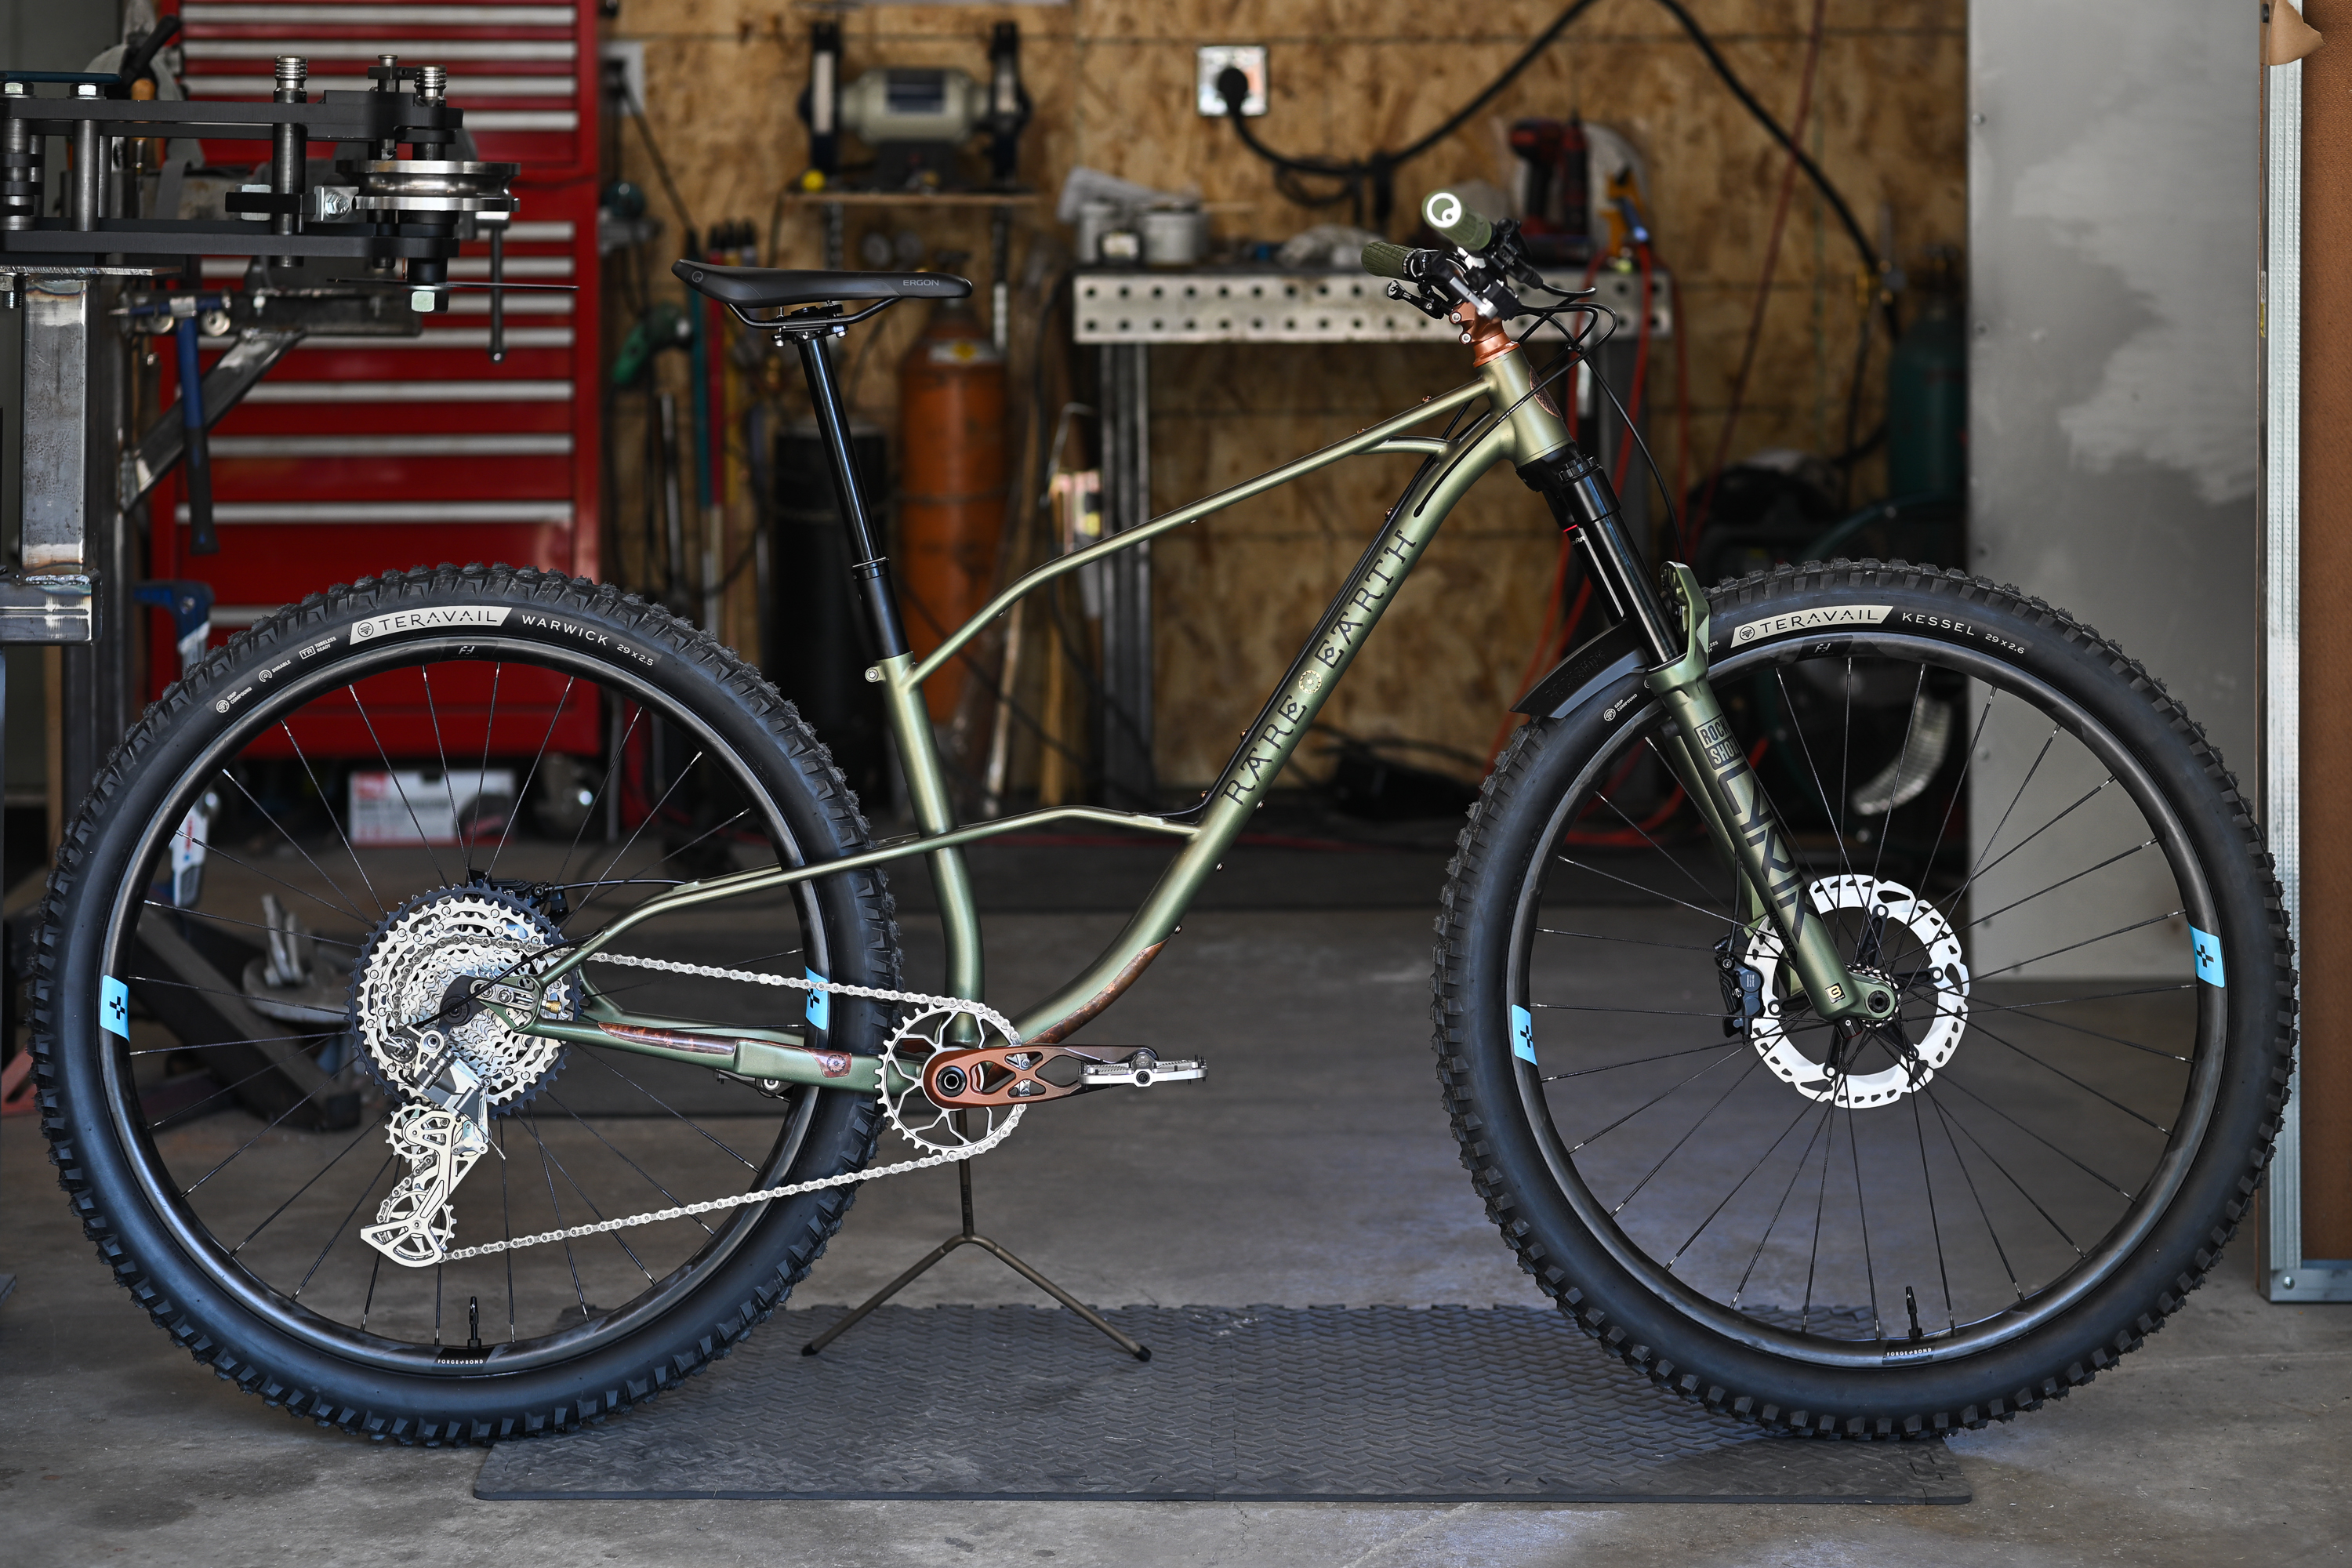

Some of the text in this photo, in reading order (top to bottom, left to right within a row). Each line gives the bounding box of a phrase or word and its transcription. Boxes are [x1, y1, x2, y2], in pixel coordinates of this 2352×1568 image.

[379, 610, 498, 631] TERAVAIL
[521, 614, 609, 646] WARWICK
[1759, 609, 1878, 633] TERAVAIL
[1902, 612, 1975, 636] KESSEL
[314, 636, 337, 648] TUBELESS
[316, 643, 332, 653] READY
[271, 659, 292, 673] DURABLE
[1220, 528, 1417, 806] RARE EARTH
[227, 691, 237, 701] GRIP
[230, 686, 252, 705] COMPOUND
[1613, 699, 1624, 709] GRIP
[1617, 693, 1638, 713] COMPOUND
[1699, 717, 1730, 747] ROCK
[1770, 911, 1795, 953] ULTIMATE
